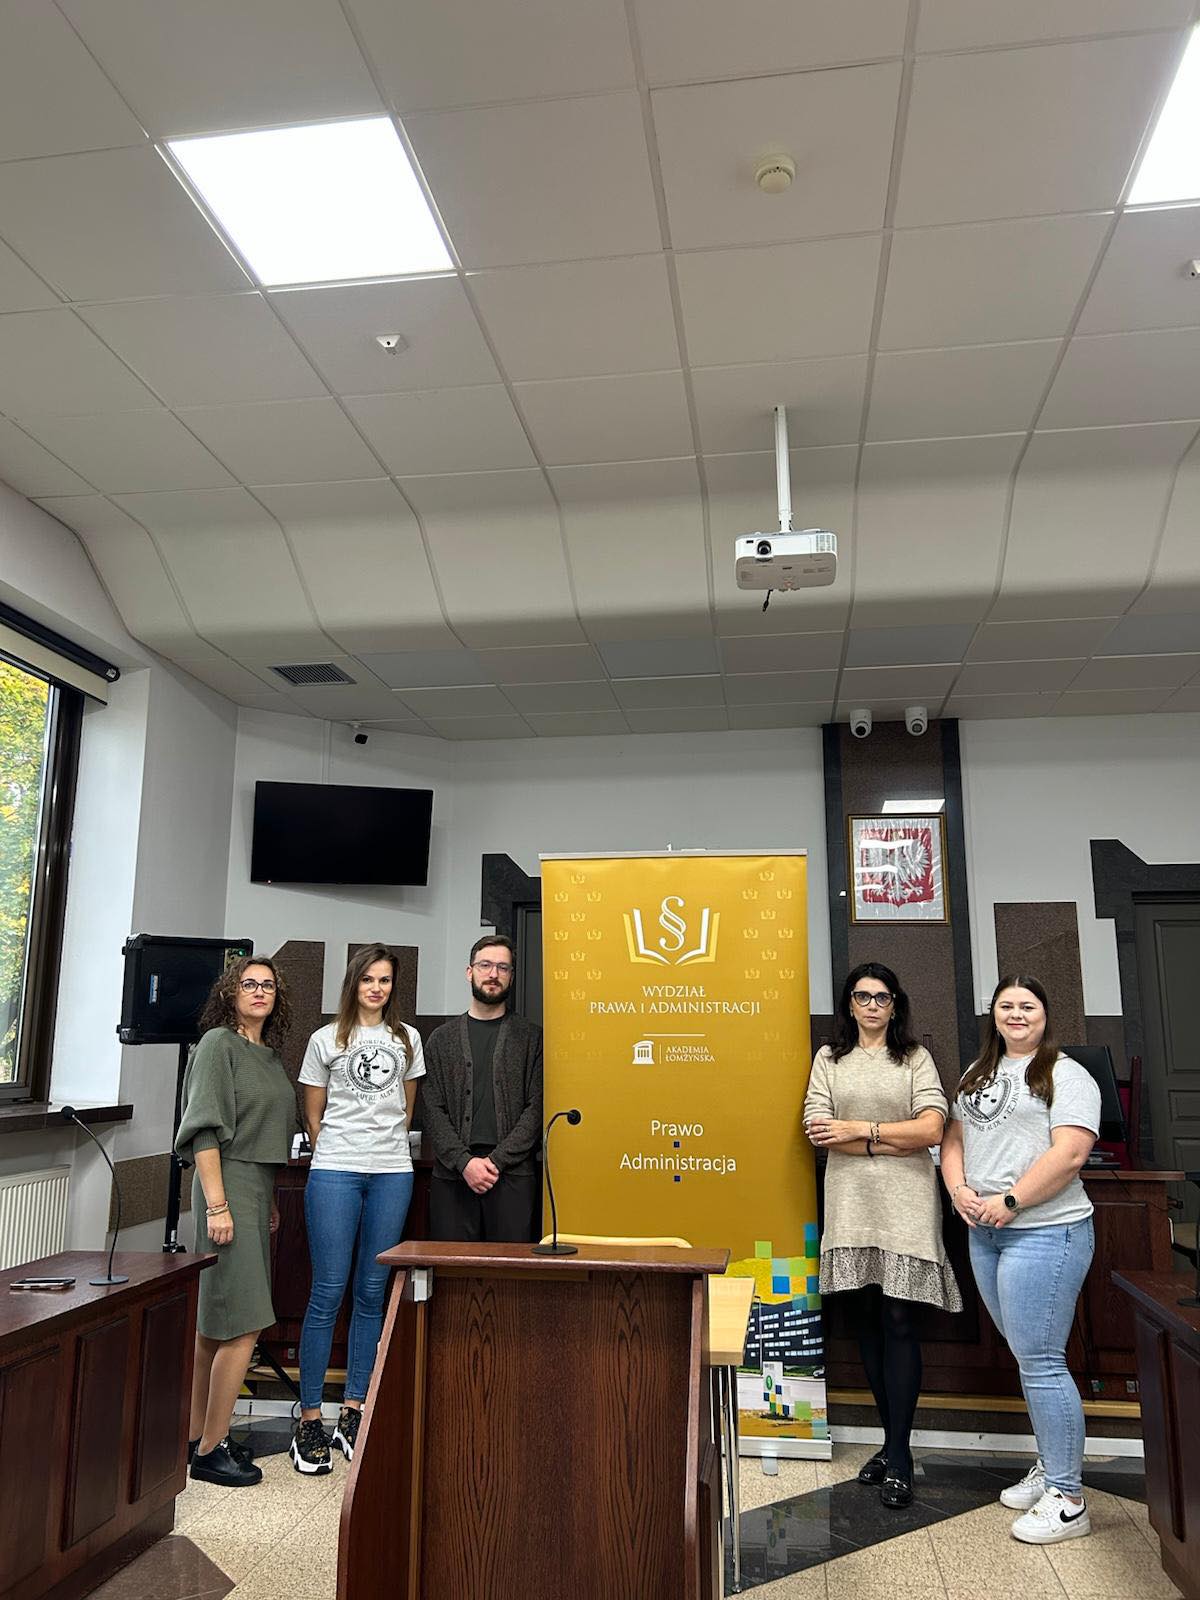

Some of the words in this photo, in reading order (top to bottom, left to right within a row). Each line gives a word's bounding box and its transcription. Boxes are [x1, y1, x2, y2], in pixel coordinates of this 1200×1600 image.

[642, 985, 706, 998] WYDZIAŁ
[590, 1002, 636, 1014] PRAWA
[648, 1002, 761, 1016] ADMINISTRACJI
[666, 1046, 710, 1054] AKADEMIA
[665, 1053, 715, 1062] ŁOMŻYŃSKA
[651, 1120, 704, 1137] Prawo
[620, 1153, 737, 1175] Administracja
